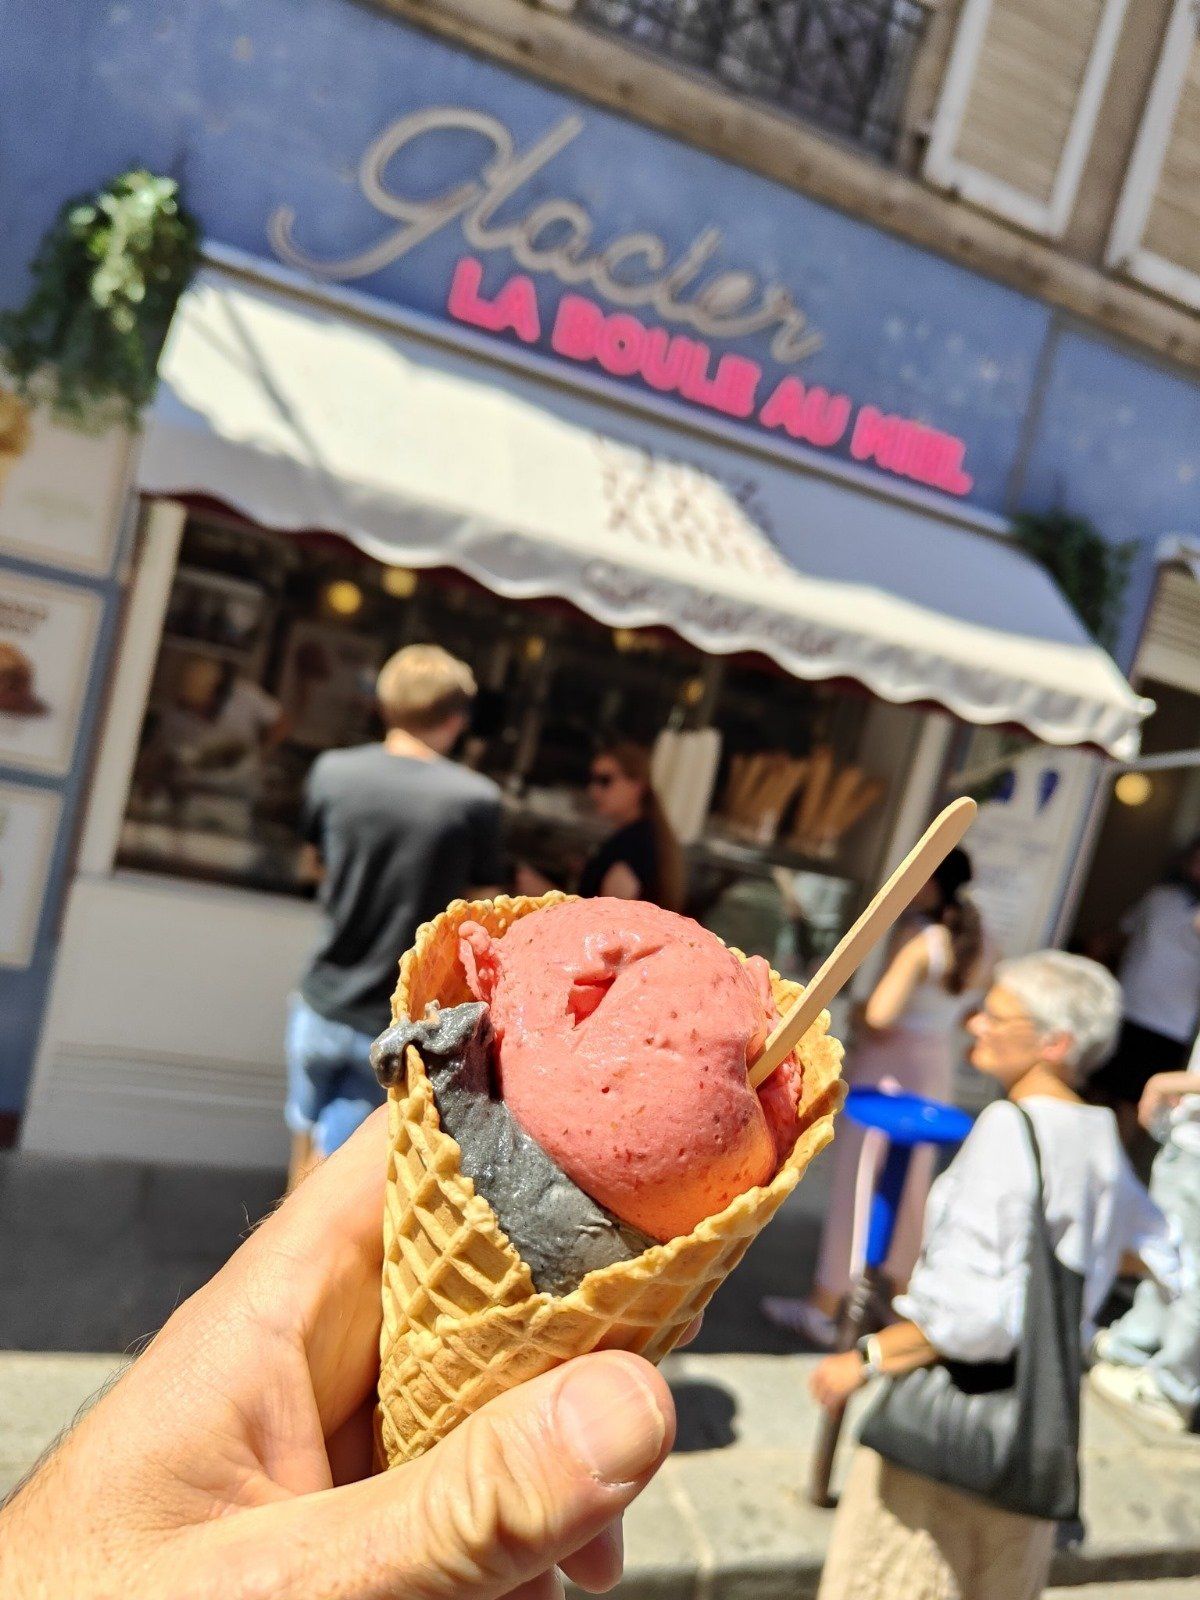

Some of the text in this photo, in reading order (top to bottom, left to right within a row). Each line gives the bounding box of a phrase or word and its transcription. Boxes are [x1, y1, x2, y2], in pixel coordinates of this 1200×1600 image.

[268, 107, 825, 364] Glacier
[447, 257, 541, 343] LA
[551, 295, 761, 417] BOULE
[760, 376, 851, 447] AU
